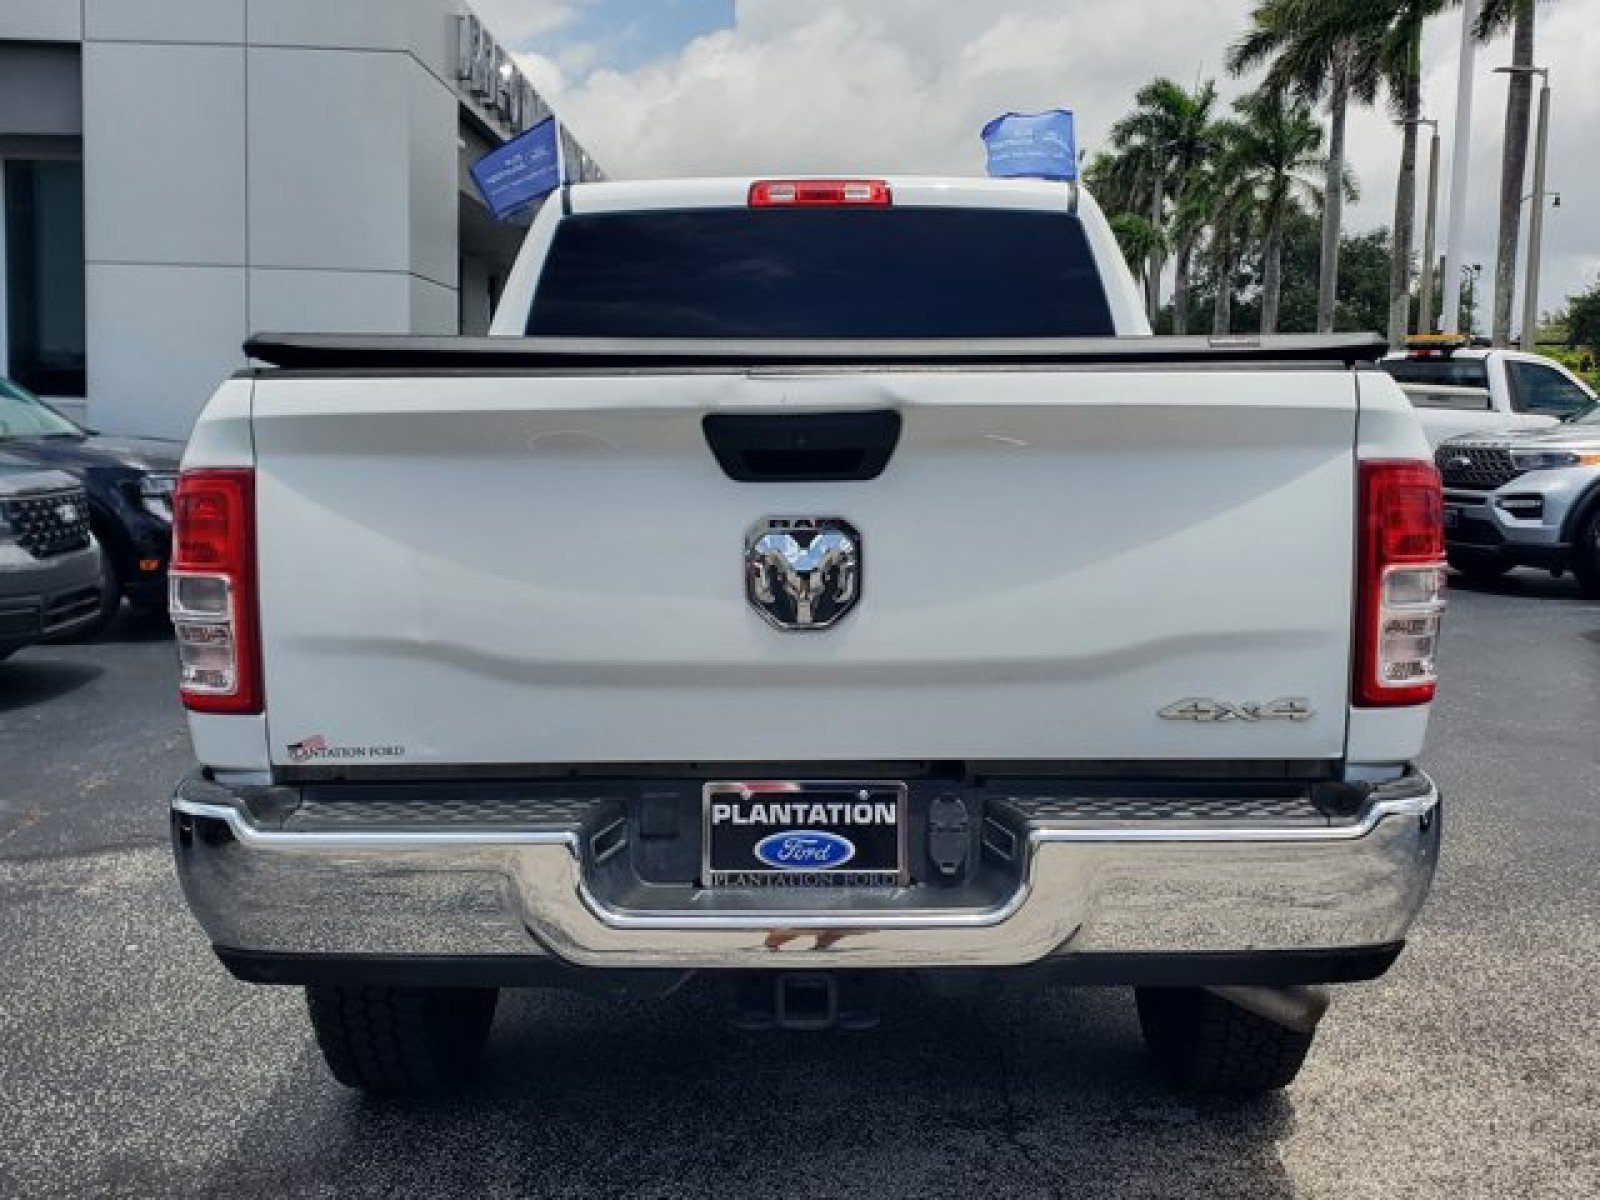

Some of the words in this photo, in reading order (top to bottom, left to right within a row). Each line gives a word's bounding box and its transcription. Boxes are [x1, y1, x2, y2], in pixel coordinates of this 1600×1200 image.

[1156, 697, 1314, 722] 4x4
[711, 803, 897, 826] PLANTATION
[777, 836, 832, 862] Ford
